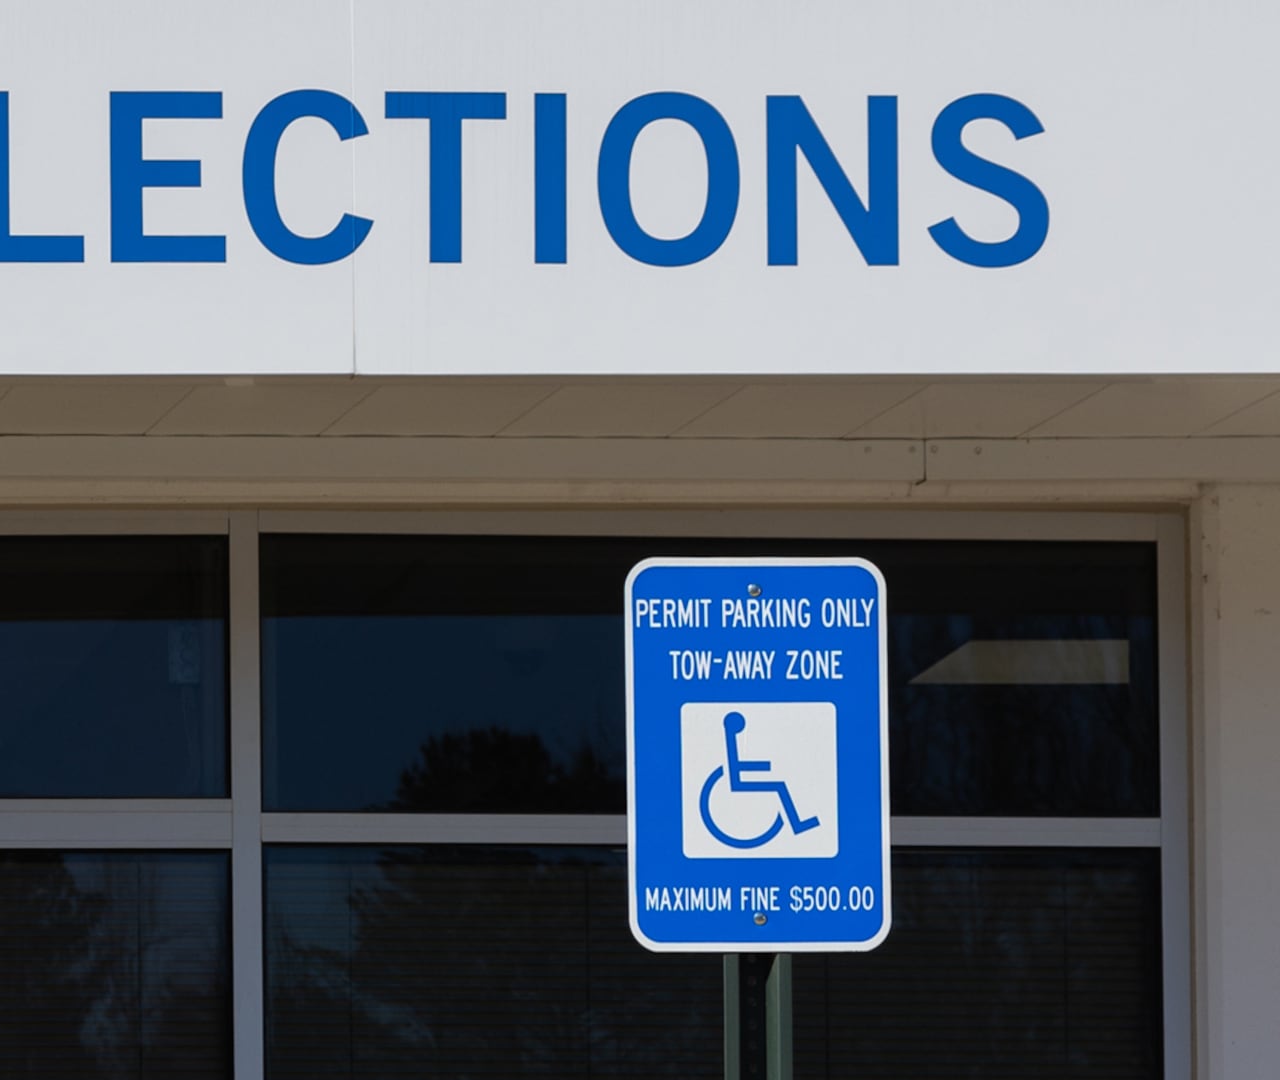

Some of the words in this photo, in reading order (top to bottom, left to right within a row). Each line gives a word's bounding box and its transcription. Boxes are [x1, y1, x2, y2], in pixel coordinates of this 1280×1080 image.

[635, 598, 712, 628] PERMIT
[721, 598, 811, 628] PARKING
[821, 598, 875, 628] ONLY
[669, 650, 776, 680] TOW-AWAY
[786, 650, 843, 680] ZONE
[645, 887, 732, 912] MAXIMUM
[740, 887, 781, 912] FINE
[789, 885, 875, 912] $500.00
